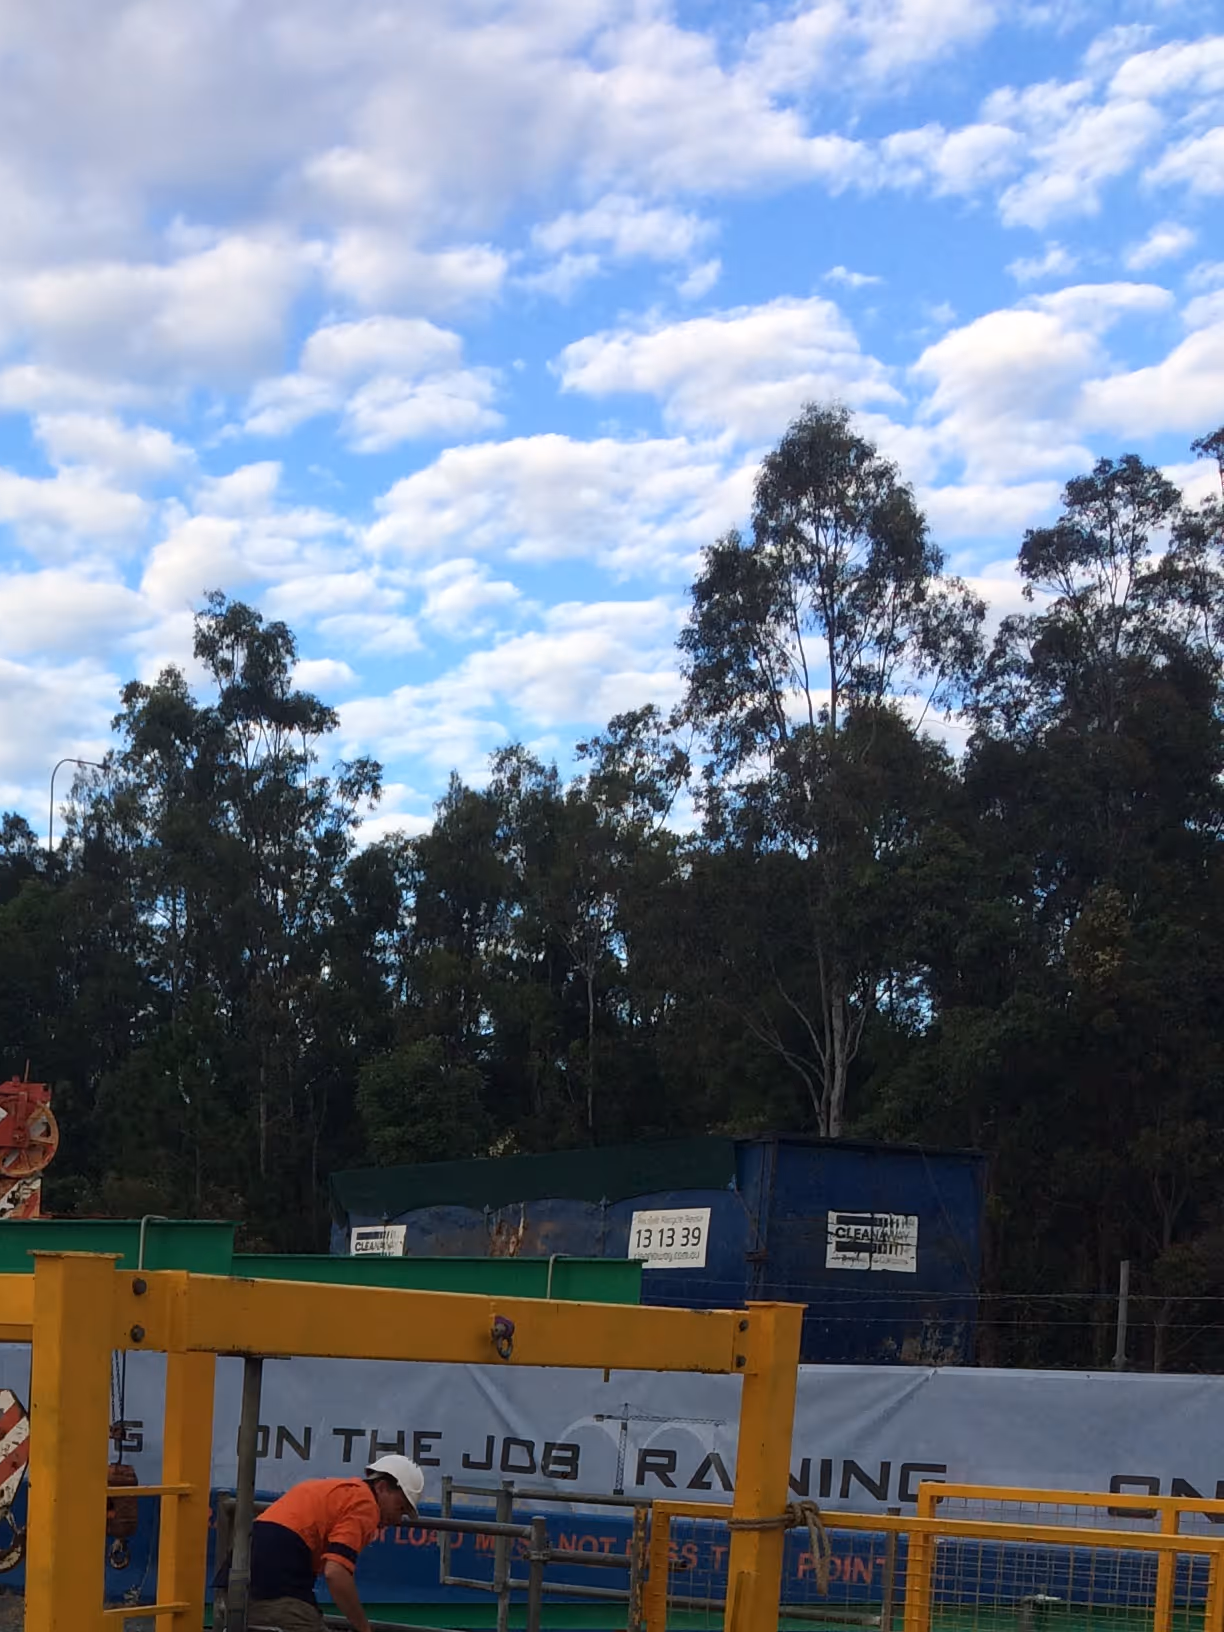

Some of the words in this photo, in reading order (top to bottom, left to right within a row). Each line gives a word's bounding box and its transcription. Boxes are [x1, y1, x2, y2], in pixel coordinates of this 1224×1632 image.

[636, 1229, 653, 1249] 13
[658, 1228, 676, 1248] 13
[680, 1226, 702, 1247] 39
[332, 1428, 443, 1467] THE
[462, 1435, 580, 1480] JOB
[558, 1534, 618, 1555] NOT
